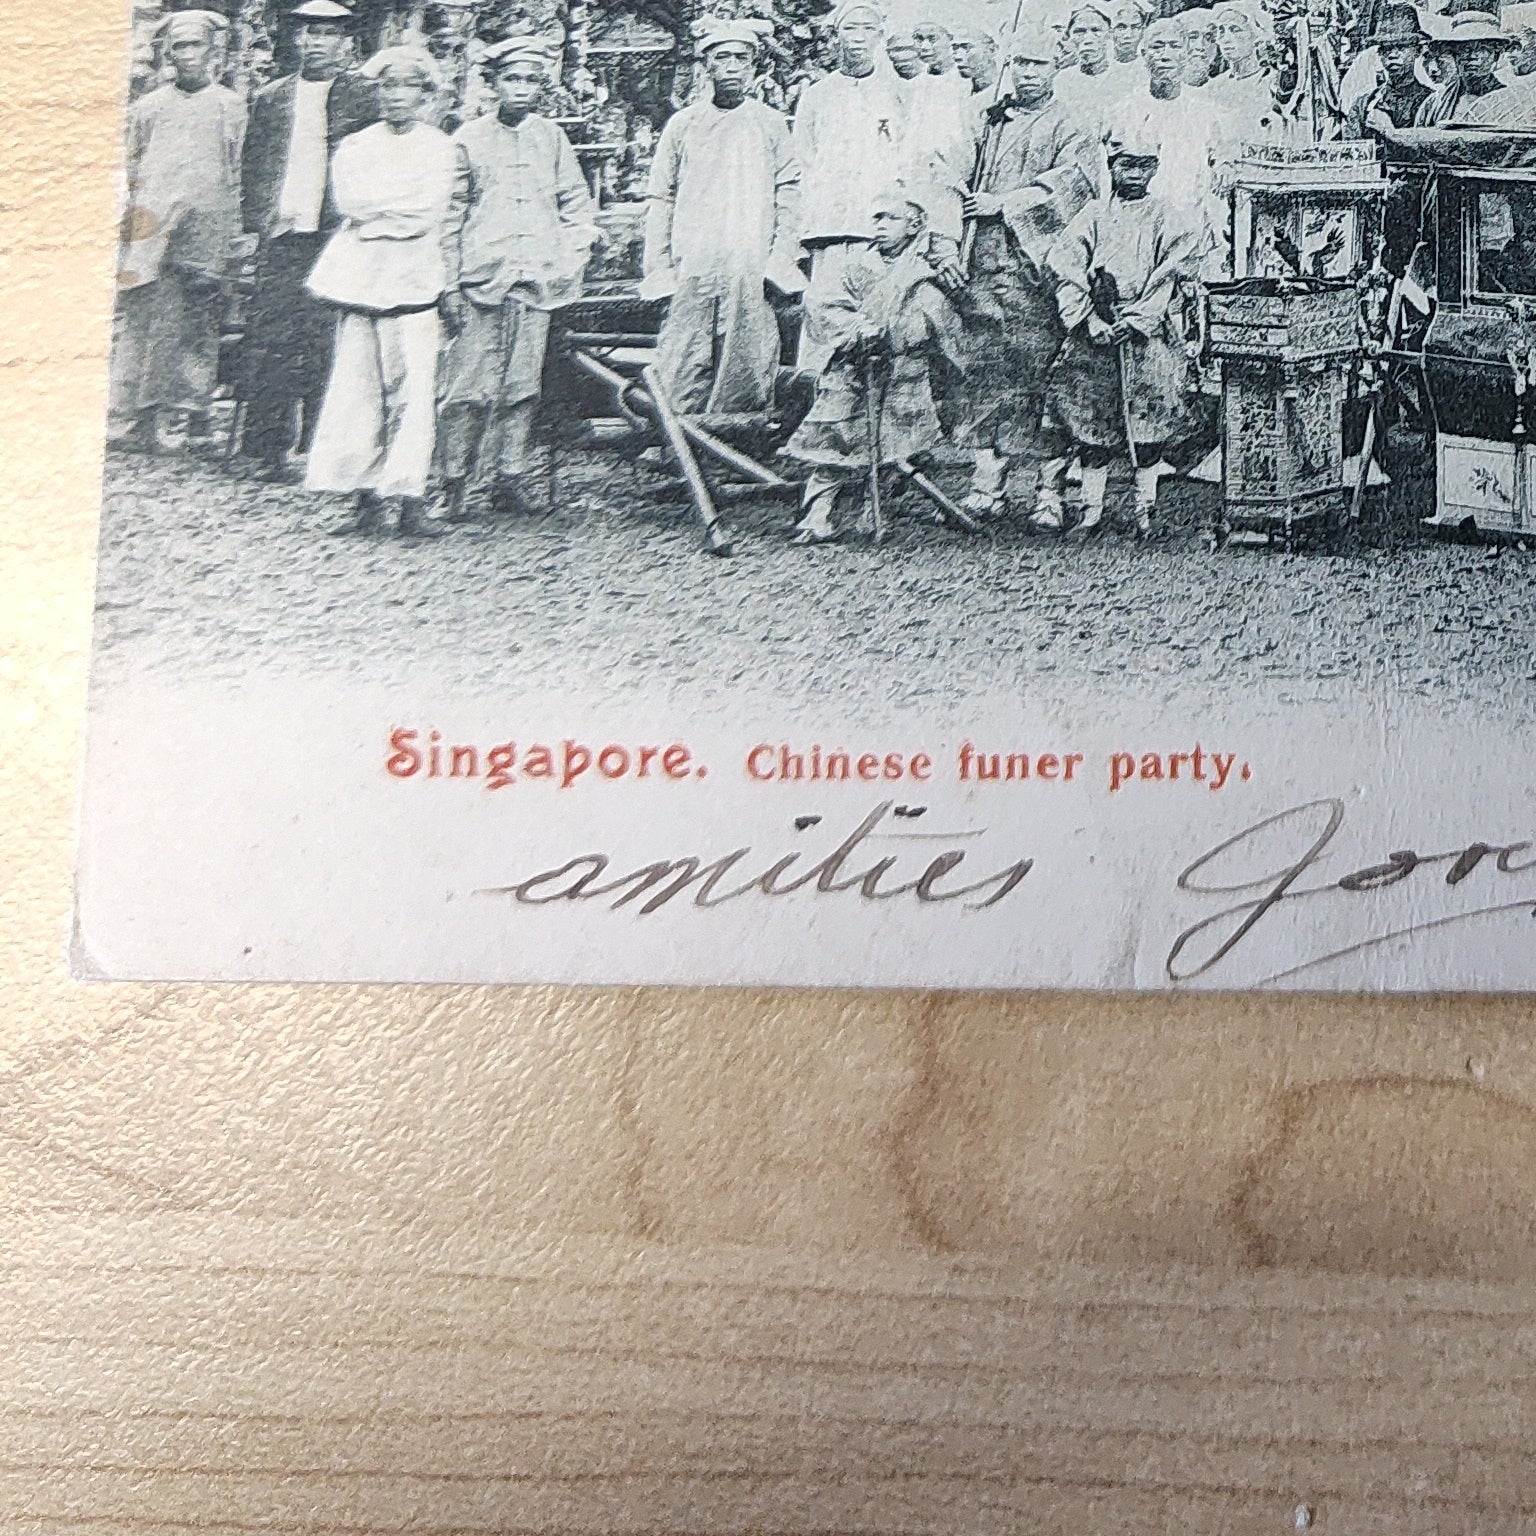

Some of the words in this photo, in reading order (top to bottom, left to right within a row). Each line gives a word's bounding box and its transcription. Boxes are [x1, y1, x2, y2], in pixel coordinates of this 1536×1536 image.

[386, 728, 709, 791] Singapore.
[746, 742, 932, 781] Chinese
[958, 741, 1084, 782] funer
